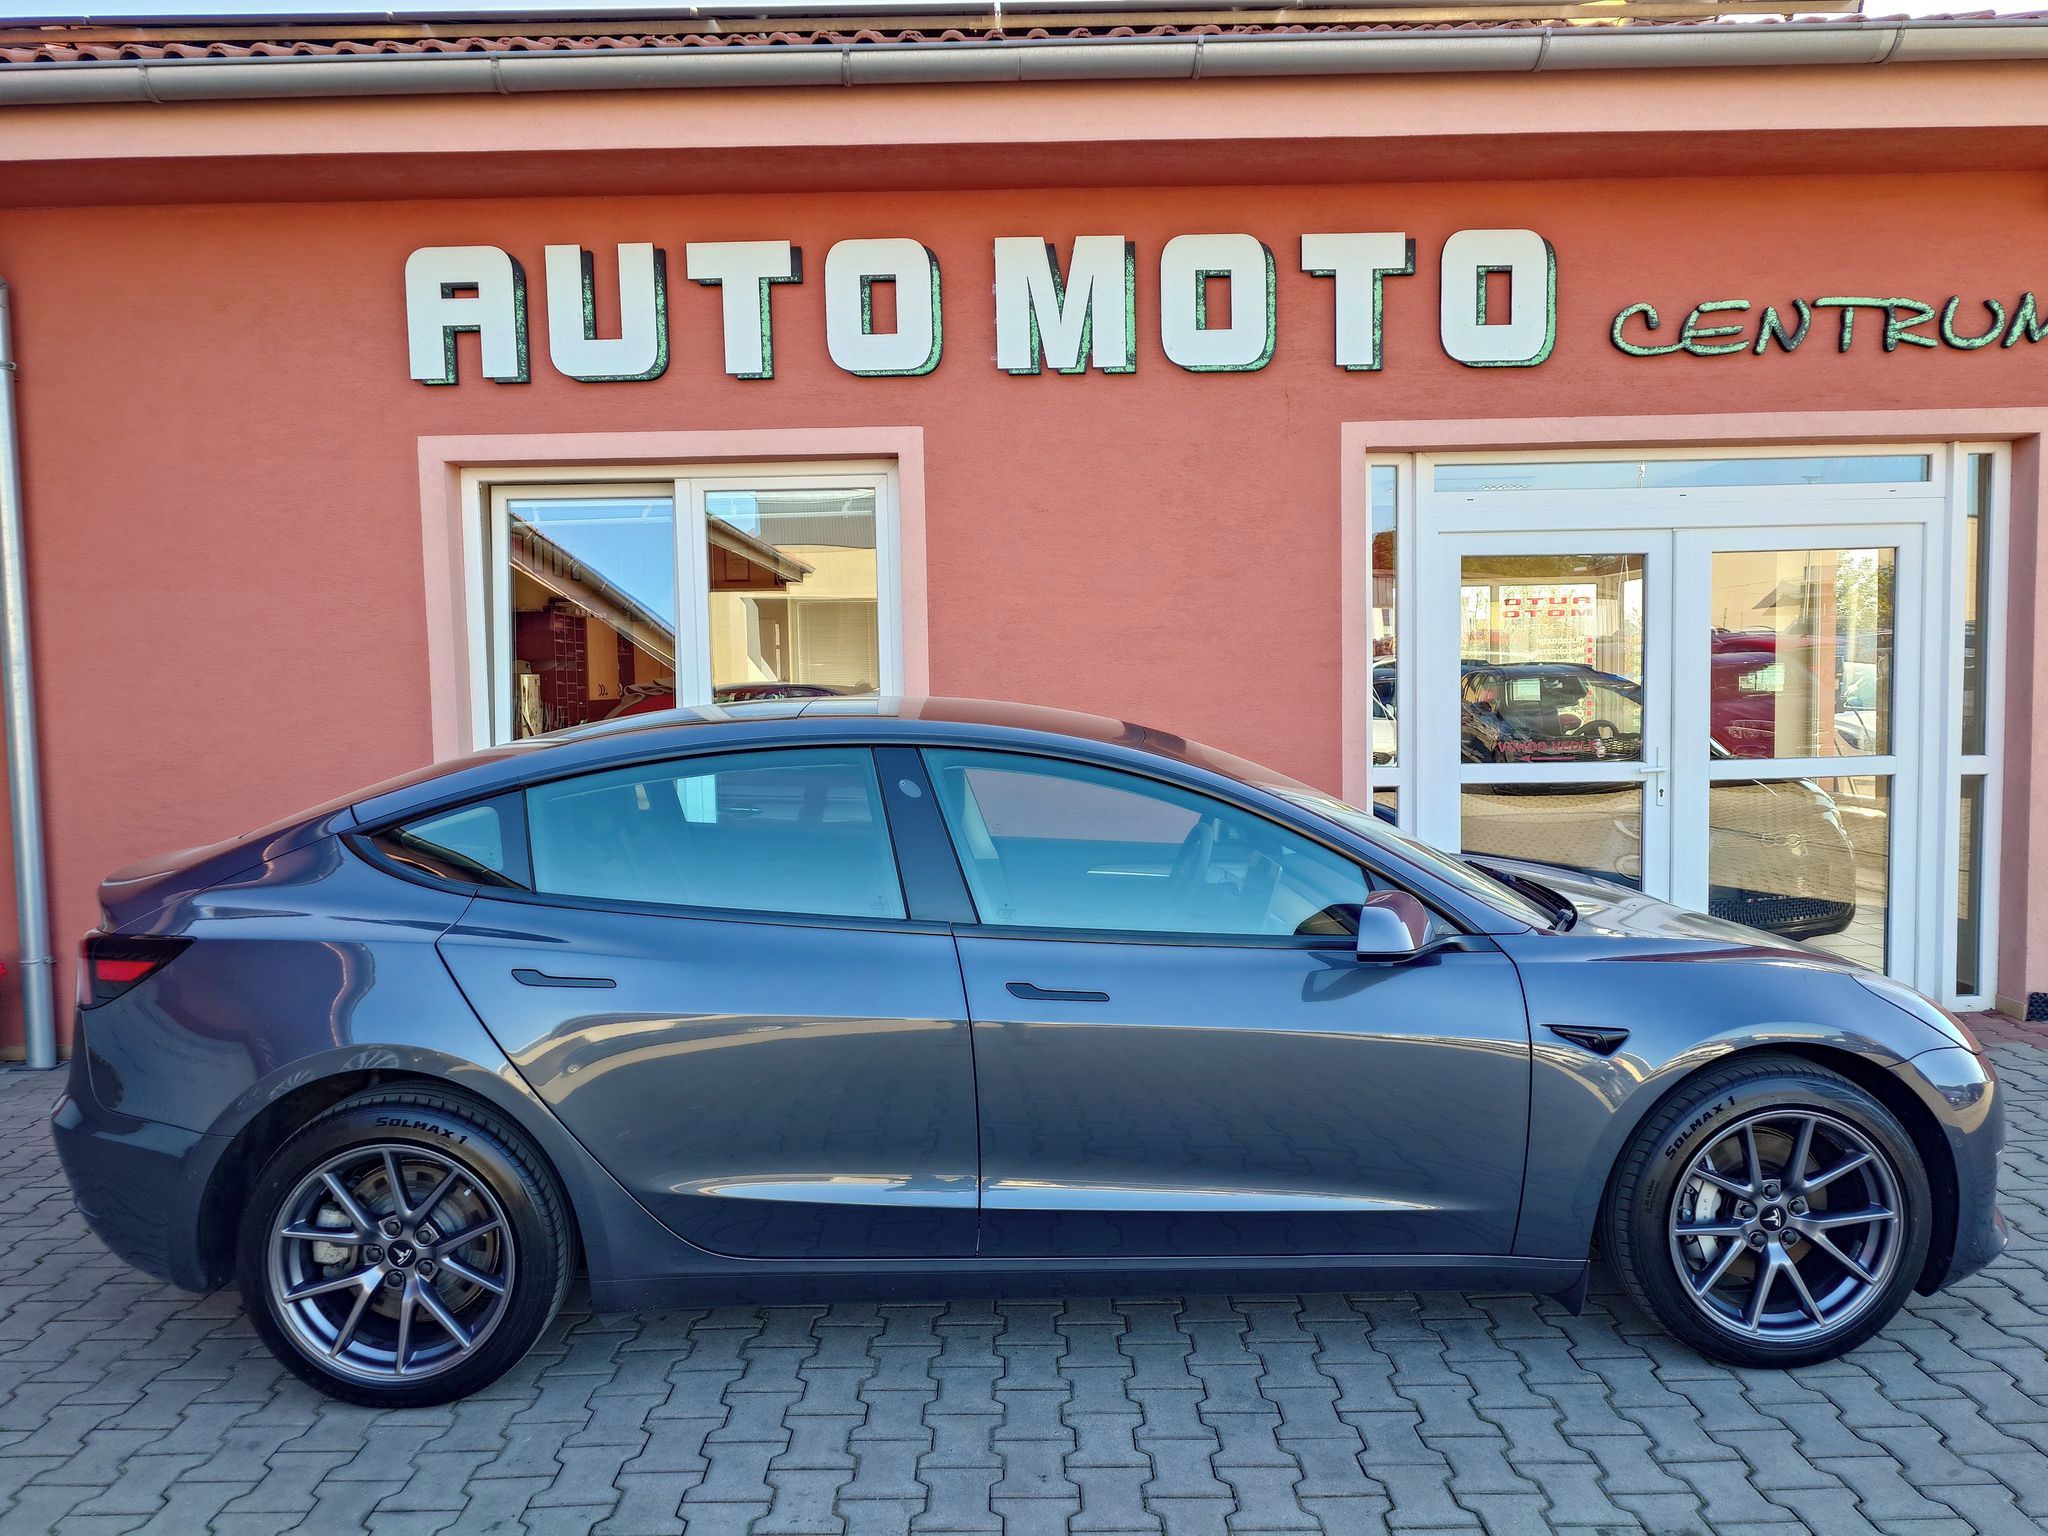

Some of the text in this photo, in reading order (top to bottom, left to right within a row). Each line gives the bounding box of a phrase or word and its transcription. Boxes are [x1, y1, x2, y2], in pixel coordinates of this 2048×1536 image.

[404, 237, 942, 384] AUTO
[994, 229, 1557, 375] MOTO
[375, 1117, 469, 1145] SOLMAX 1
[1664, 1095, 1736, 1160] SOLMAX 1
